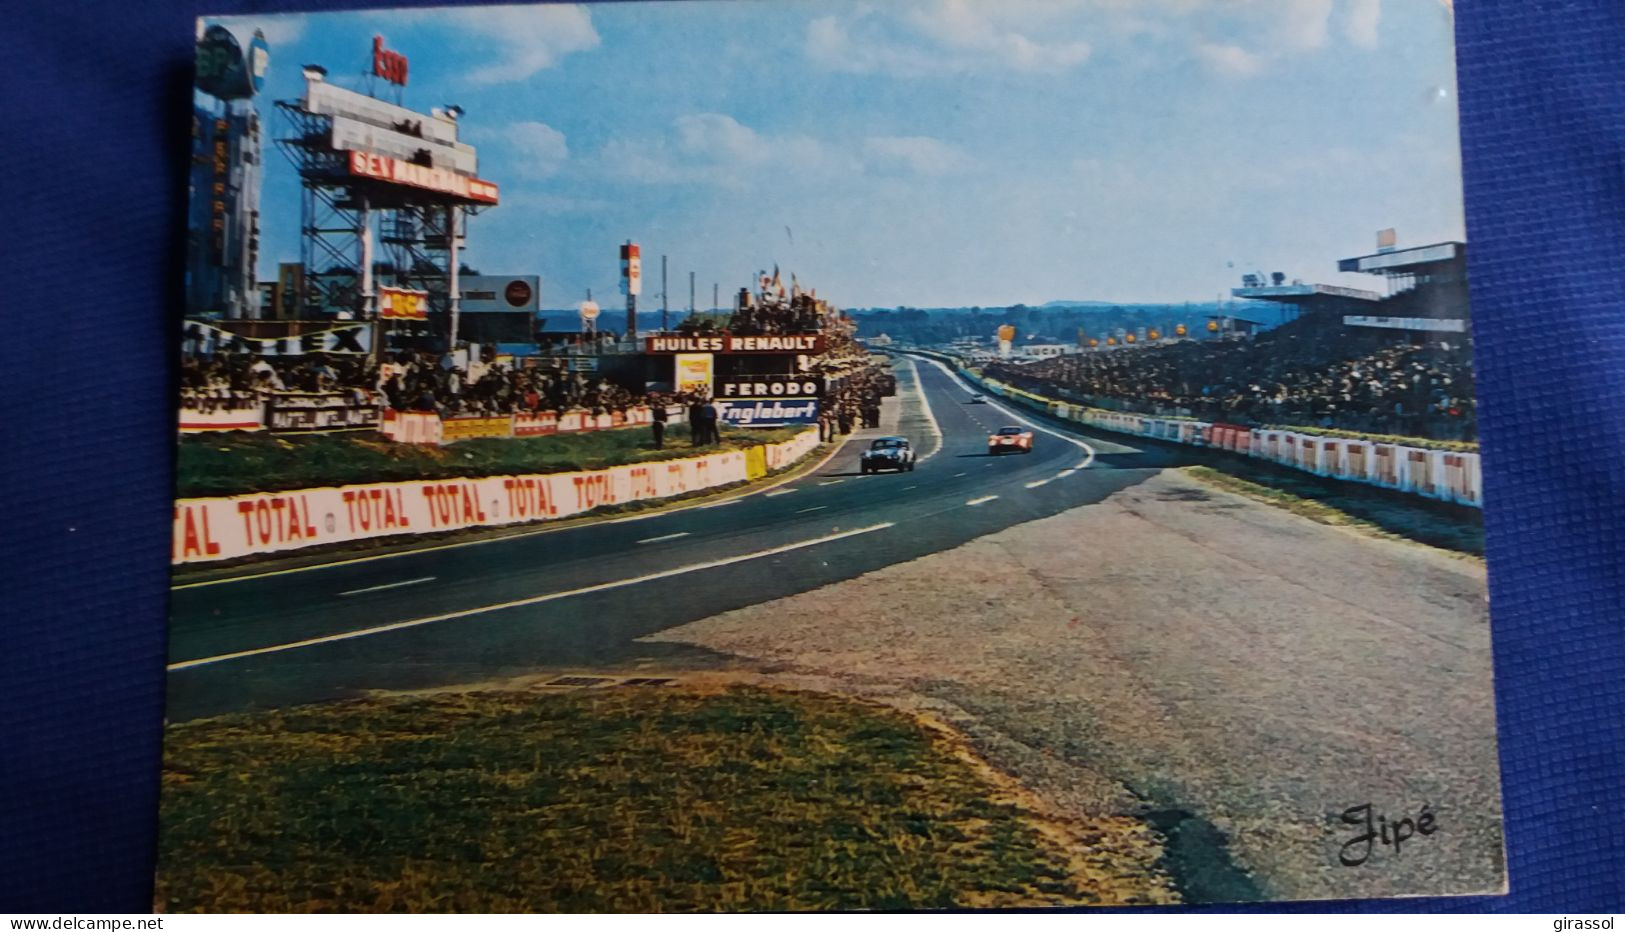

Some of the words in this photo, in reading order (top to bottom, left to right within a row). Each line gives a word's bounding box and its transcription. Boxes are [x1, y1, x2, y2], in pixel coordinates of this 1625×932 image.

[653, 337, 723, 351] HUILES
[730, 336, 817, 351] RENAULT
[724, 382, 817, 396] FERODO
[719, 401, 816, 424] Englebert
[238, 495, 316, 546] TOTAL
[343, 488, 409, 533] TOTAL
[423, 483, 485, 528] TOTAL
[504, 478, 557, 518] TOTAL
[573, 474, 616, 509] TOTAL
[1340, 803, 1440, 866] Jipé
